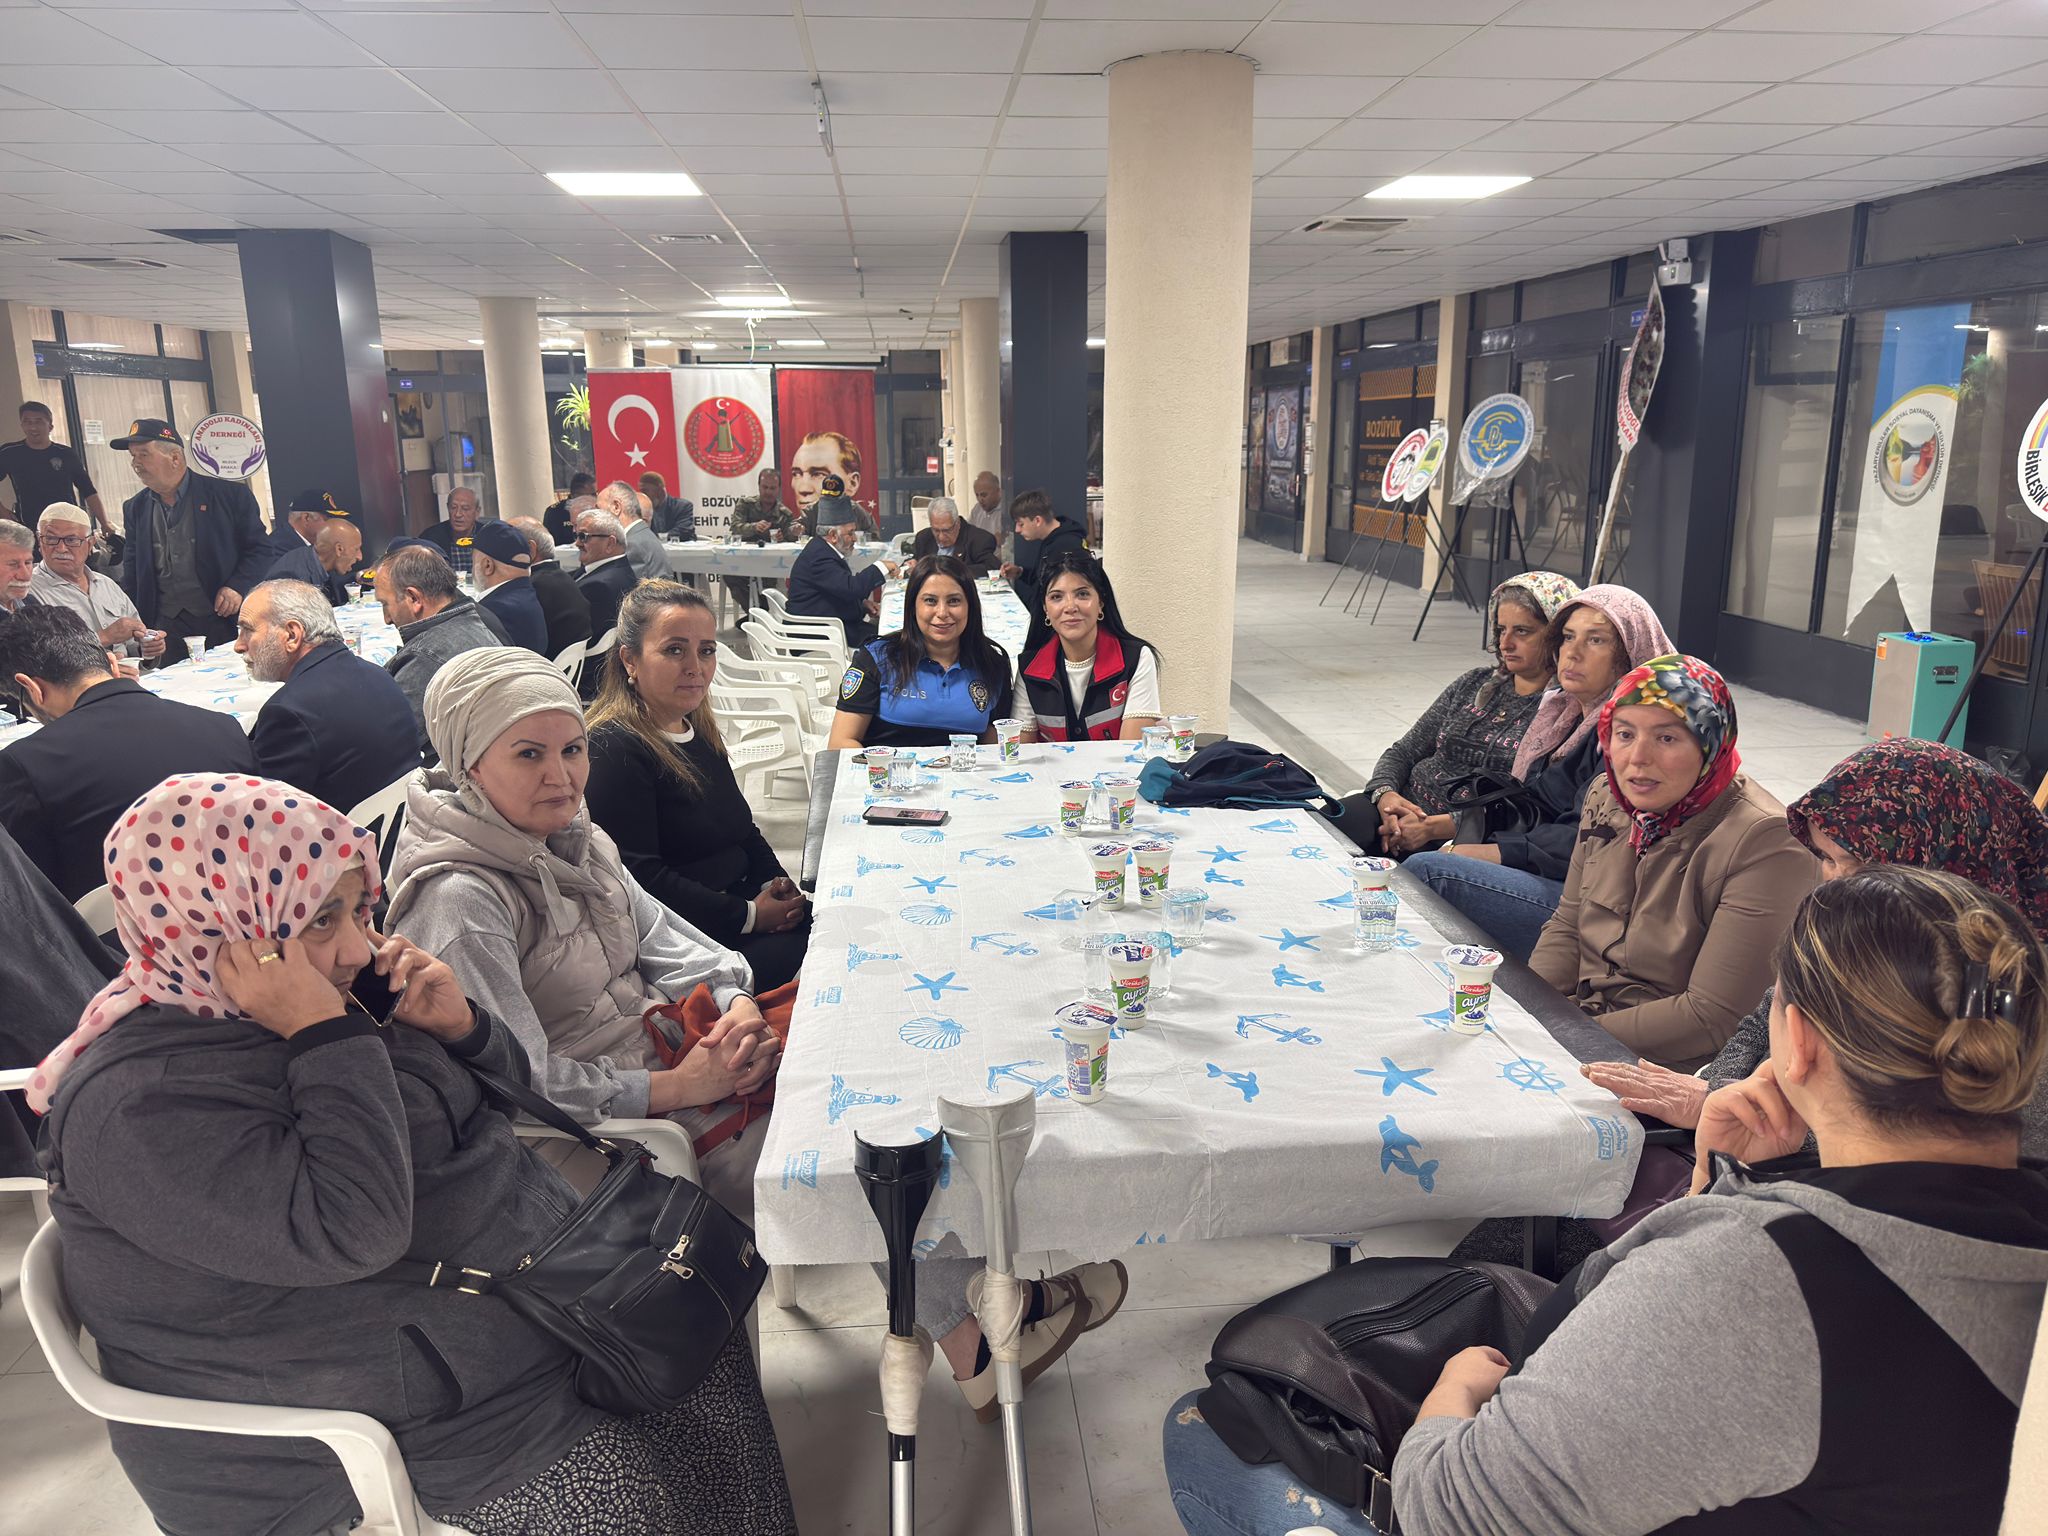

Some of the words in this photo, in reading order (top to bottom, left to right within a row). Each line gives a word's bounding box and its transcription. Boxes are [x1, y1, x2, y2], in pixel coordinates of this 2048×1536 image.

[195, 416, 223, 441] ANADOLU
[224, 416, 262, 443] KADINLARI
[1366, 416, 1402, 438] BOZÜYÜK
[2025, 450, 2048, 506] BİRLEŞİK
[694, 514, 719, 527] EHİT
[1097, 878, 1119, 891] ayran
[1595, 1120, 1613, 1158] Floppy
[800, 1150, 818, 1186] Floppy
